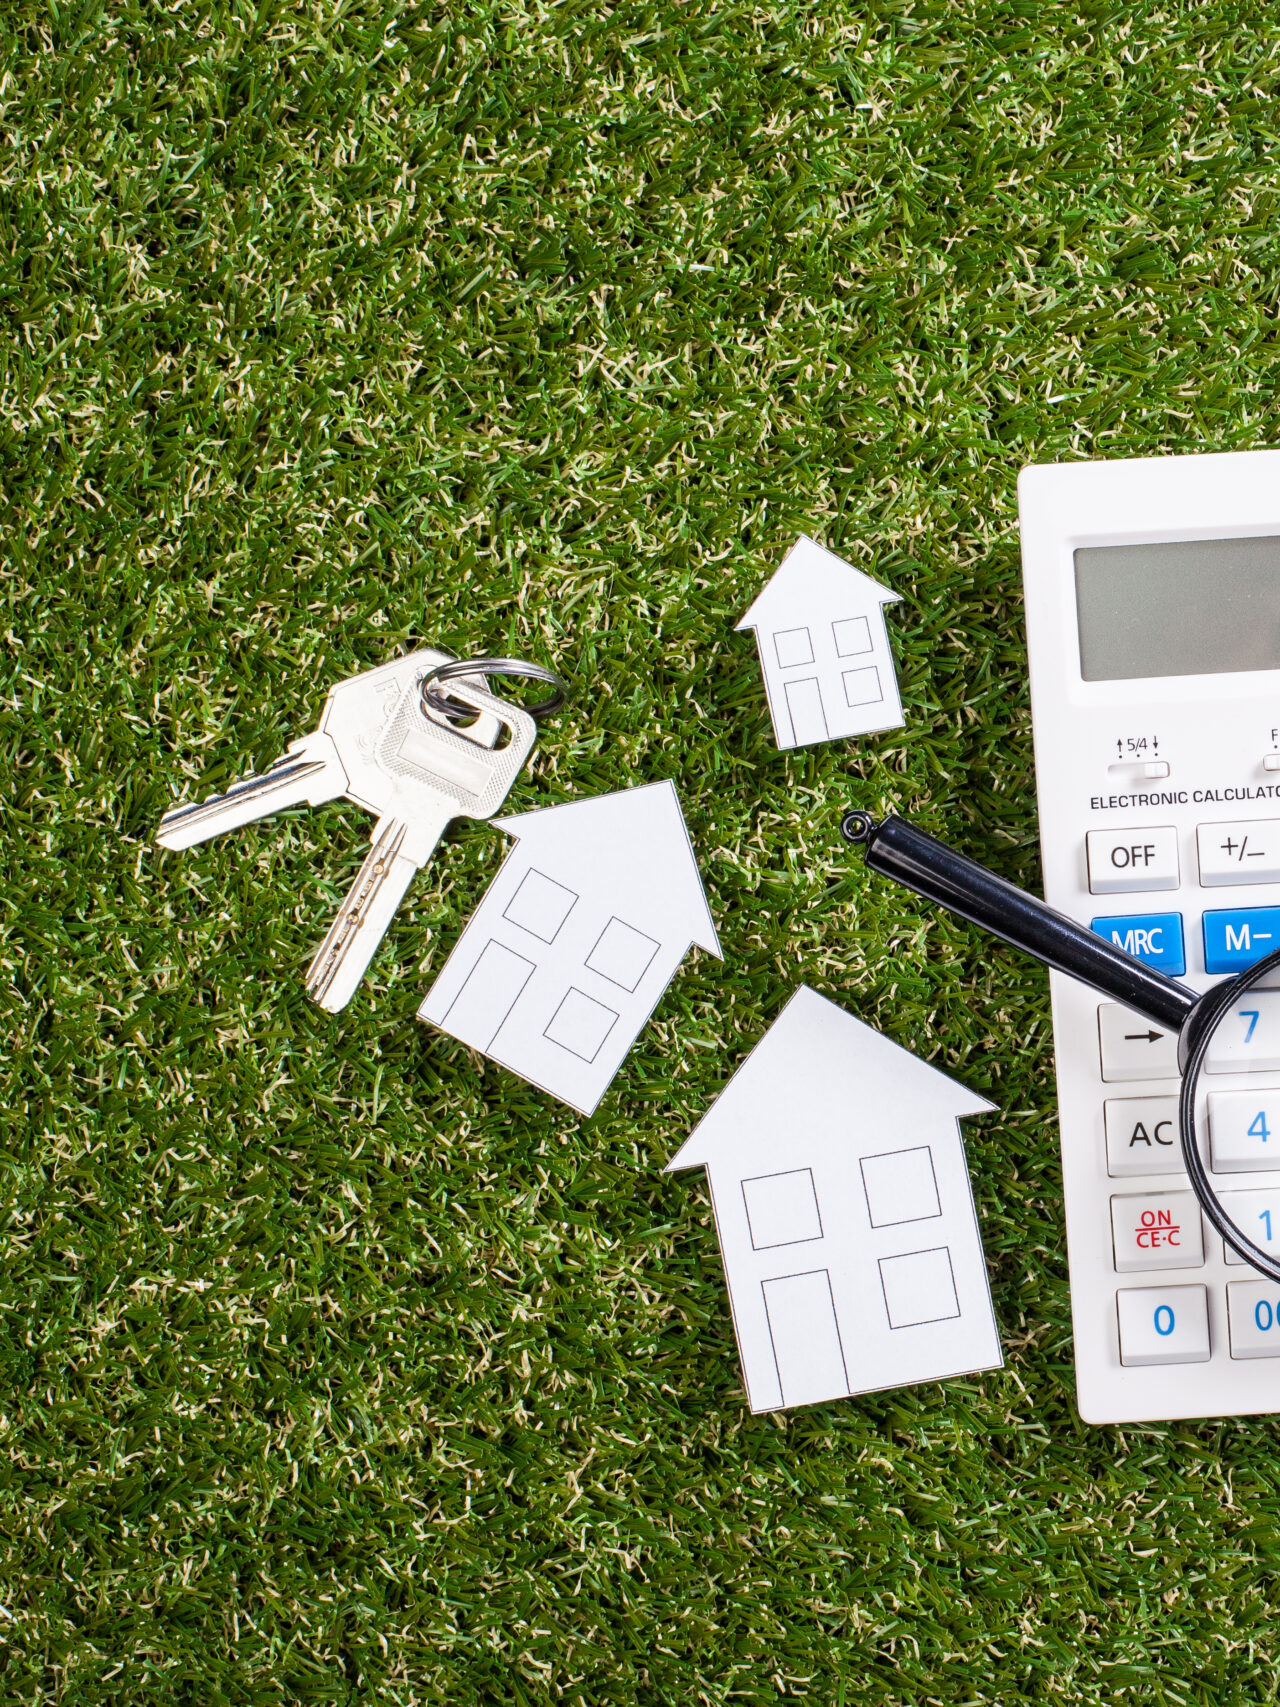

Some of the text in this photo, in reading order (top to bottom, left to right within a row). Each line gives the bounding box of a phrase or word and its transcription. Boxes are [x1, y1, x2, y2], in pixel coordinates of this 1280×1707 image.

[1127, 736, 1149, 753] 5/4
[1271, 727, 1279, 743] F
[1090, 791, 1189, 810] ELECTRONIC
[1110, 844, 1156, 869] OFF
[1111, 927, 1164, 956] MRC
[1238, 1009, 1261, 1044] 7
[1128, 1120, 1174, 1148] AC
[1246, 1110, 1272, 1143] 4
[1140, 1209, 1174, 1228] ON
[1258, 1209, 1273, 1241] 1
[1152, 1304, 1176, 1337] 0
